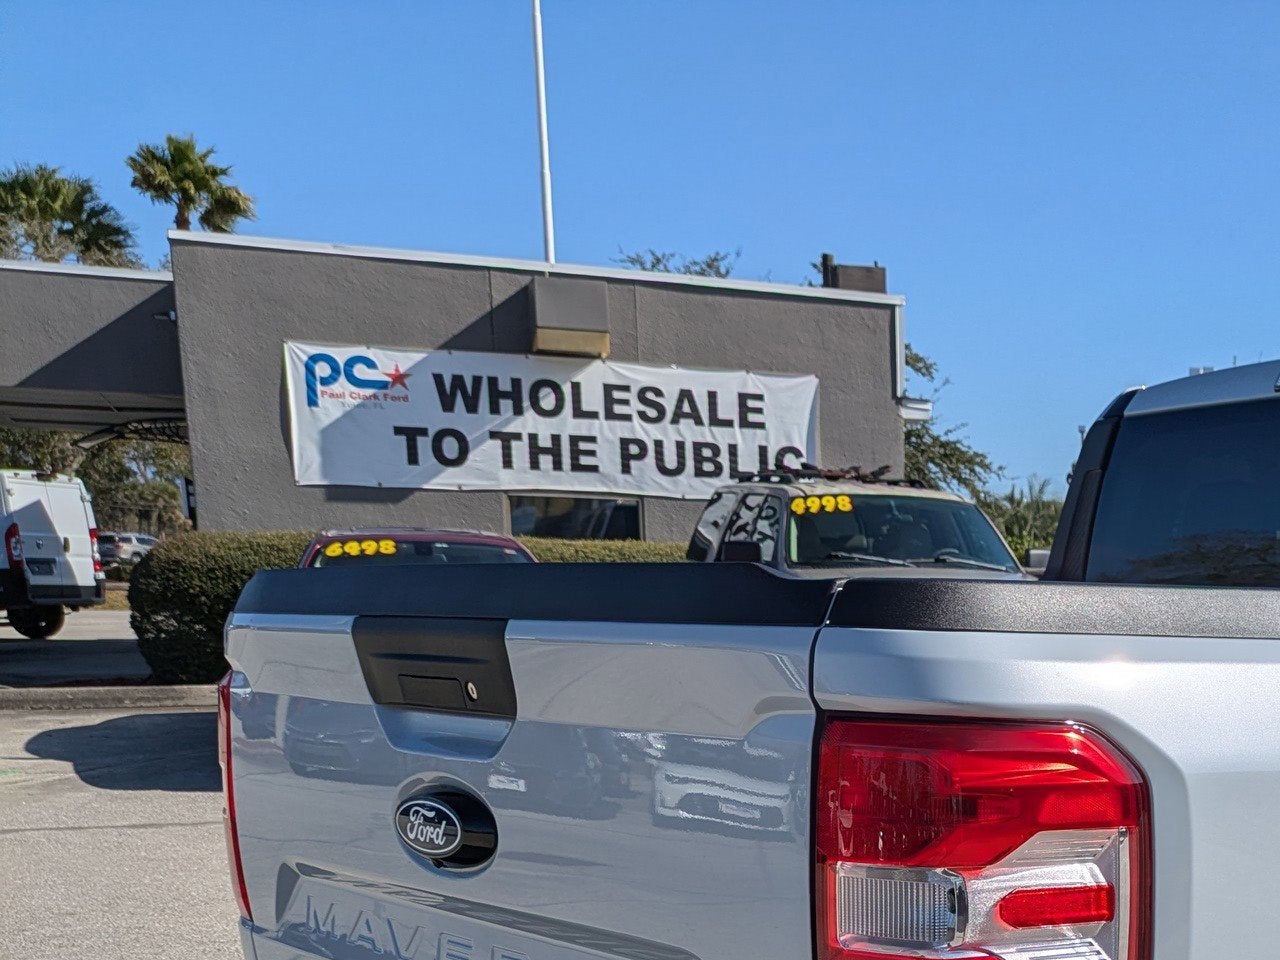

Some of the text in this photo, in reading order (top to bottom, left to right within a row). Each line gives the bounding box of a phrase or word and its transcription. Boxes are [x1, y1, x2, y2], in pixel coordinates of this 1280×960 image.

[320, 389, 409, 402] Paul Clark Ford
[431, 372, 767, 431] WHOLESALE
[393, 425, 805, 479] TO THE PUBLIC
[406, 806, 447, 846] Ford
